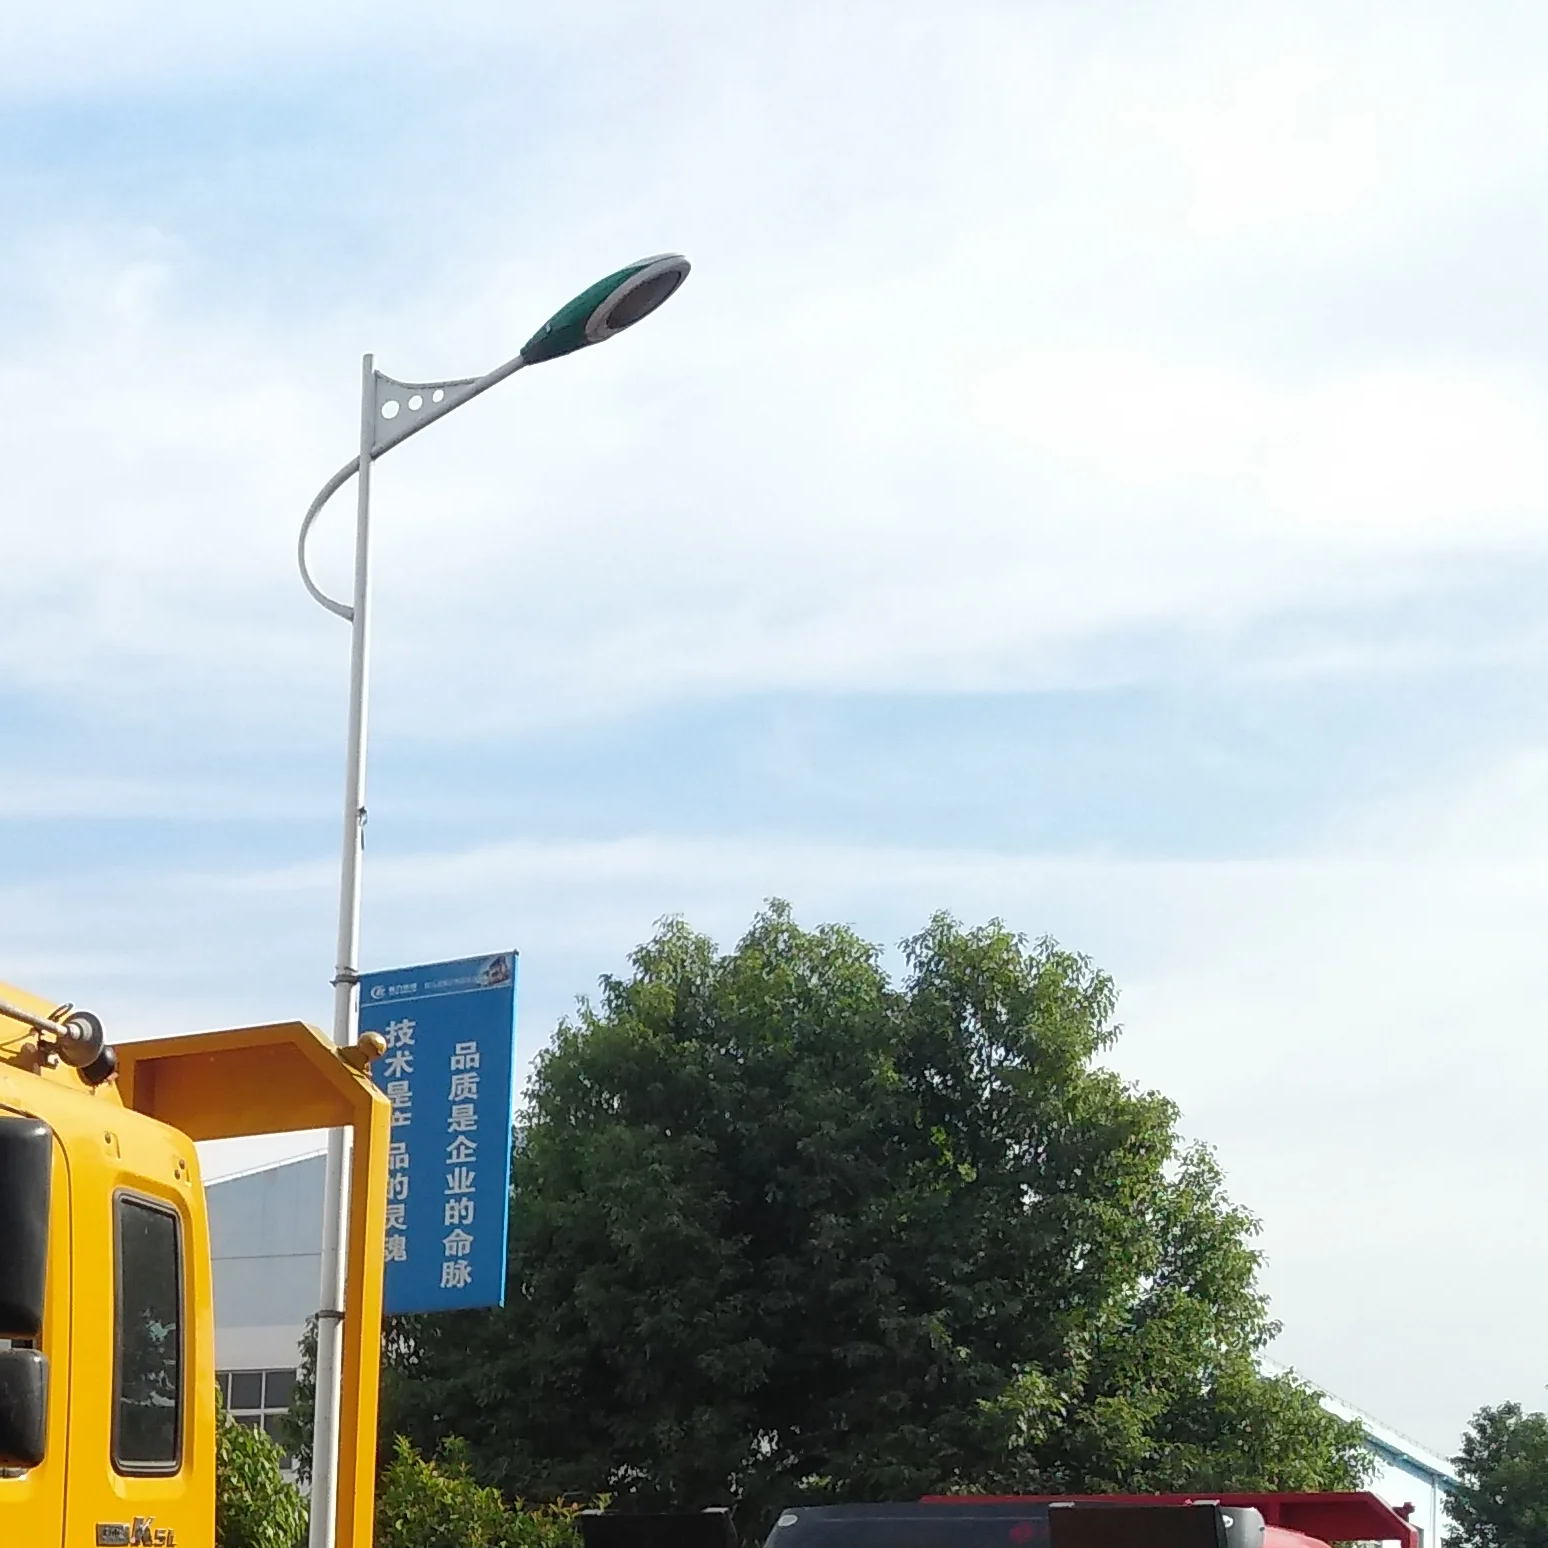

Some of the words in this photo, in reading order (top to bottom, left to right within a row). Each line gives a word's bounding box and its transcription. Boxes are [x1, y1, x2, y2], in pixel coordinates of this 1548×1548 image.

[440, 1041, 480, 1288] 品质是企业的命脉
